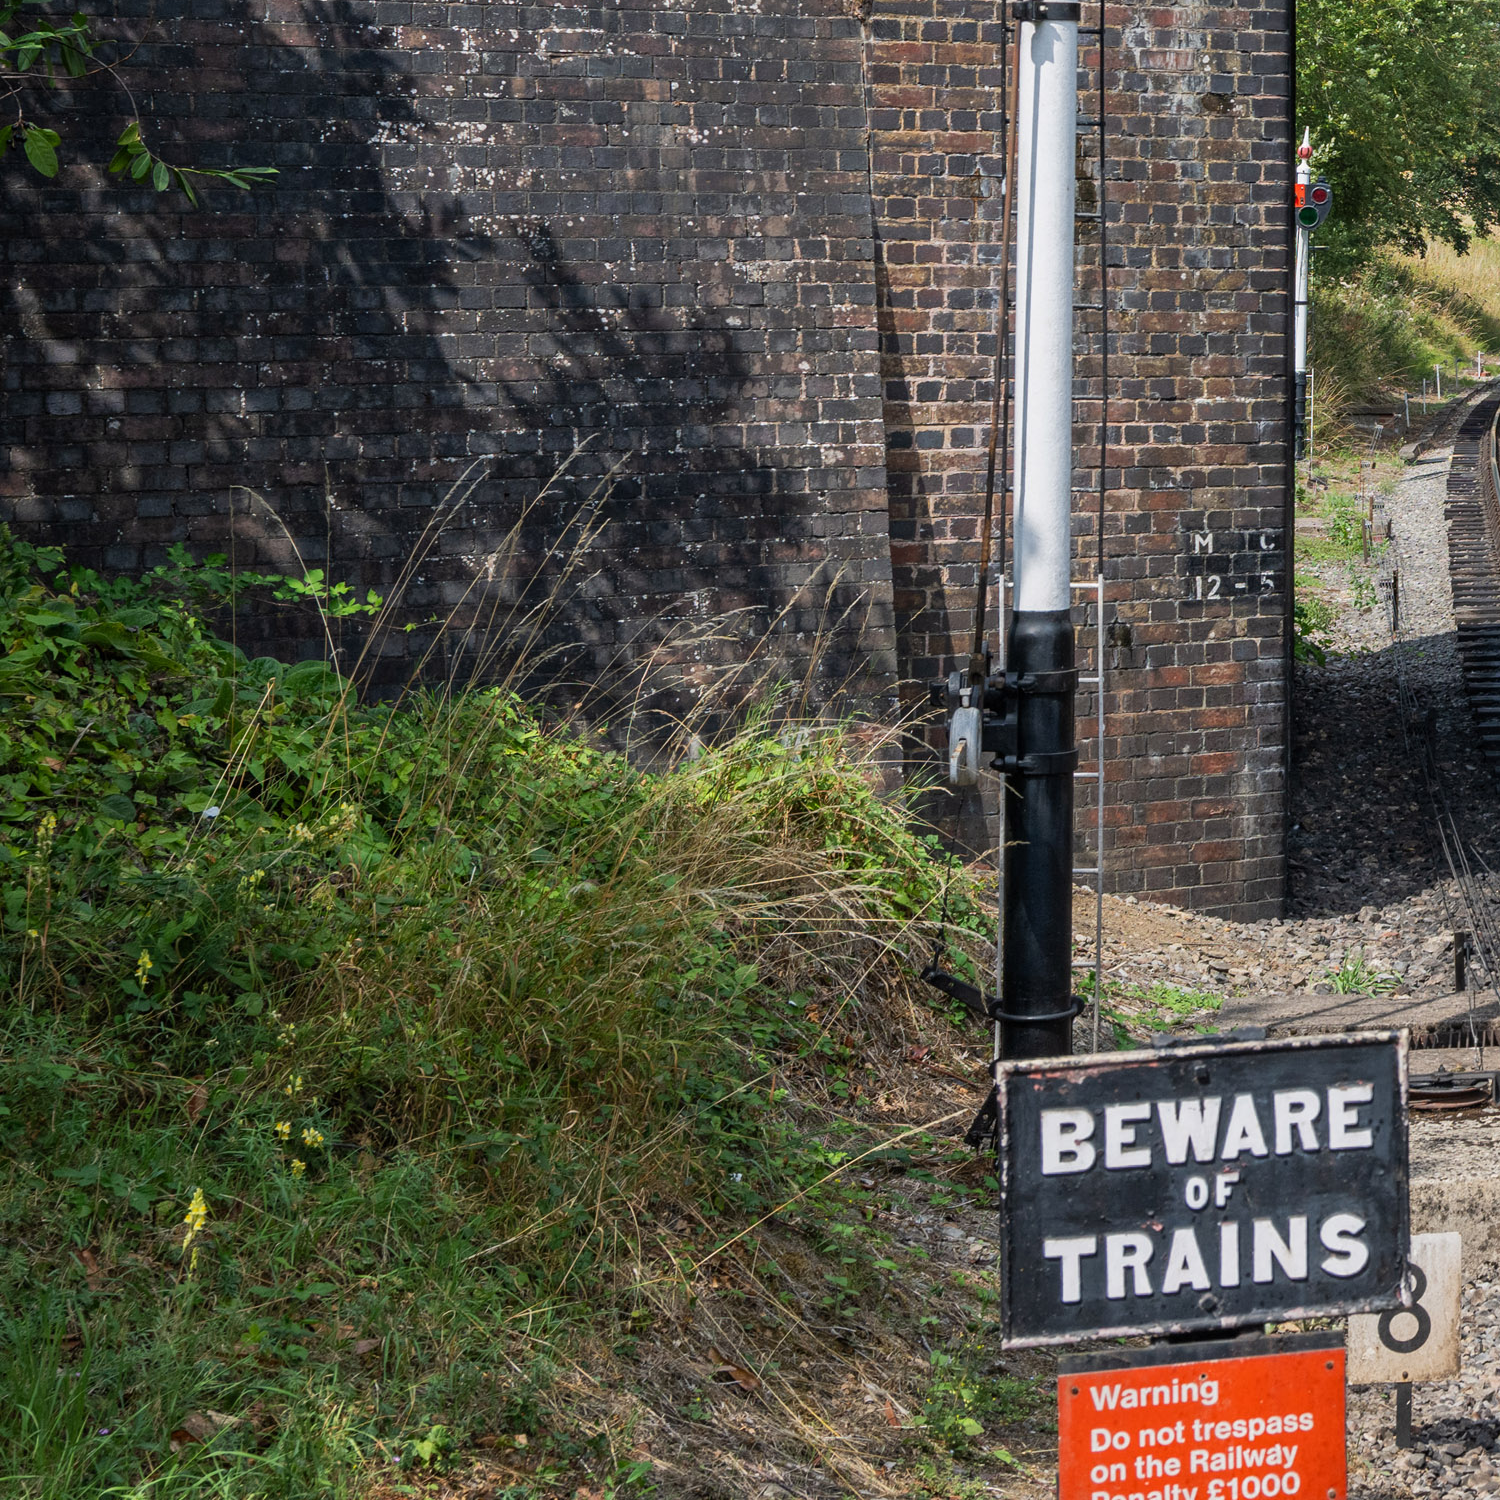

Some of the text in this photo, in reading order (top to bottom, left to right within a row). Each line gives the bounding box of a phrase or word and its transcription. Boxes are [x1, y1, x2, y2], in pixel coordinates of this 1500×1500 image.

[1194, 532, 1213, 554] M
[1041, 1083, 1374, 1175] BEWARE
[1185, 1172, 1241, 1211] OF
[1043, 1213, 1371, 1304] TRAINS
[1378, 1263, 1431, 1354] 8
[1089, 1378, 1220, 1412] Warning
[1090, 1412, 1315, 1453] Do not trespass
[1090, 1444, 1298, 1484] on the Railway
[1207, 1471, 1301, 1500] £1000
